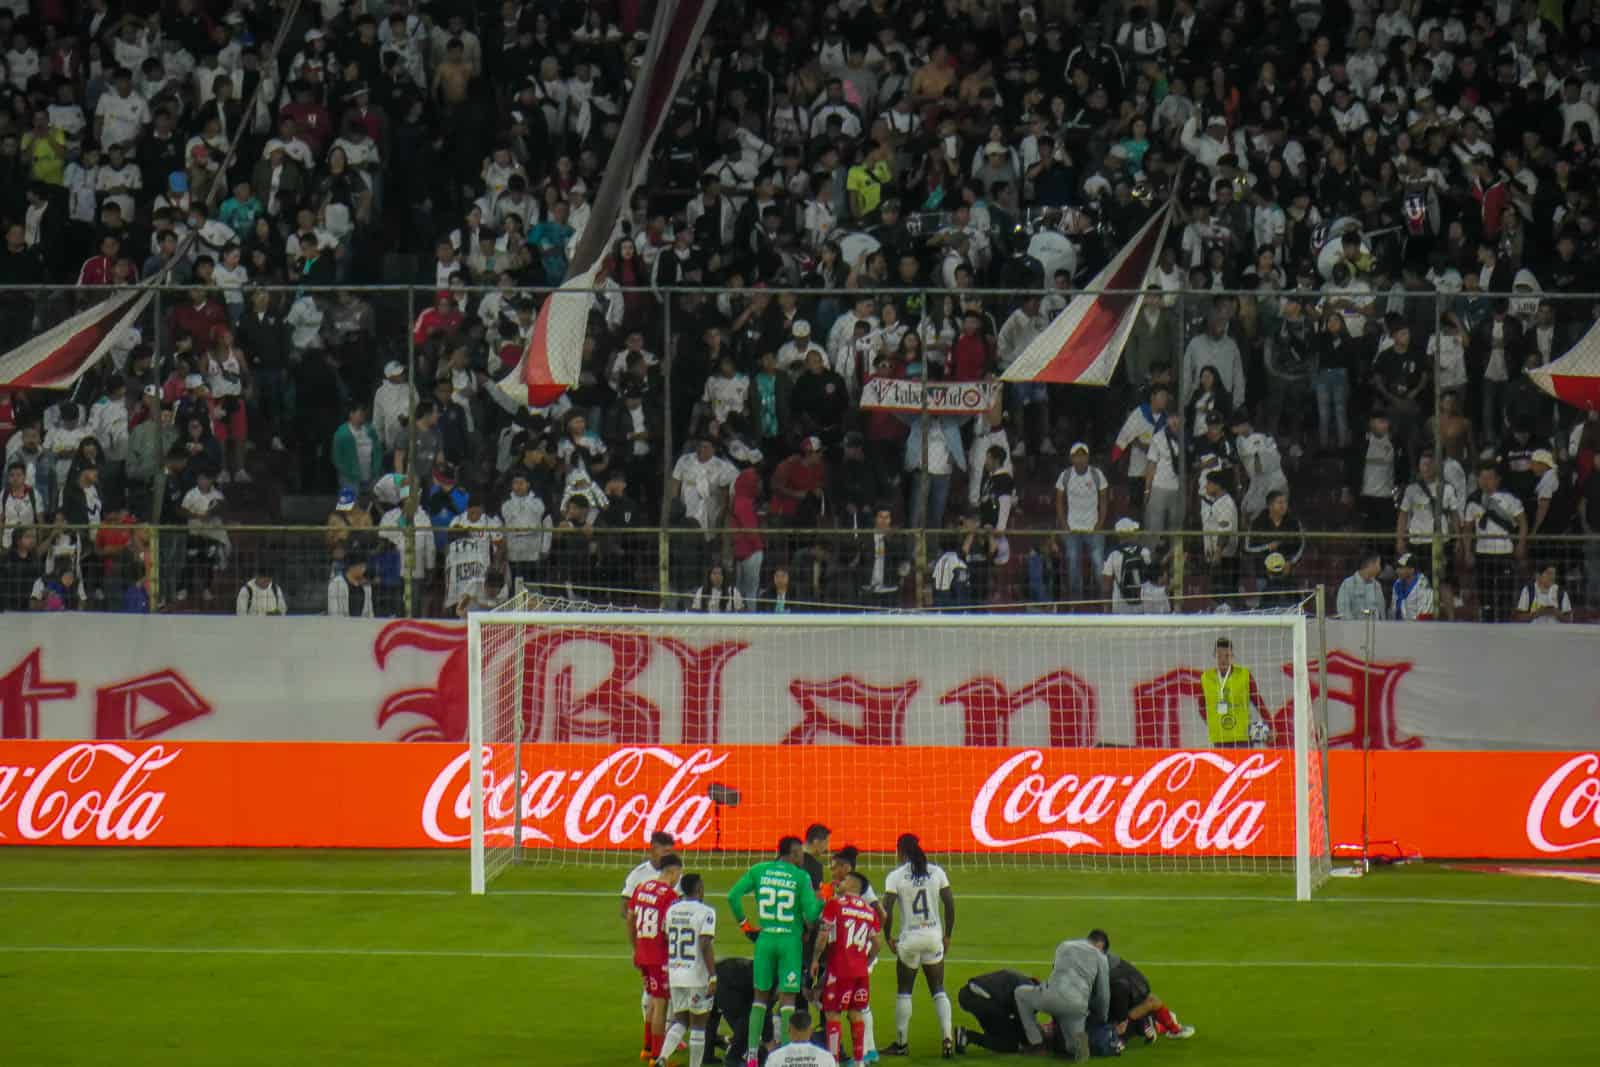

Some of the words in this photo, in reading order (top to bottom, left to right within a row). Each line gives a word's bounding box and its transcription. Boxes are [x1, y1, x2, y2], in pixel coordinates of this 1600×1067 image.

[422, 746, 730, 845] Coca-Cola
[970, 749, 1282, 851] Coca-Cola
[1525, 752, 1600, 852] Co
[759, 886, 795, 923] 22
[912, 888, 930, 921] 4
